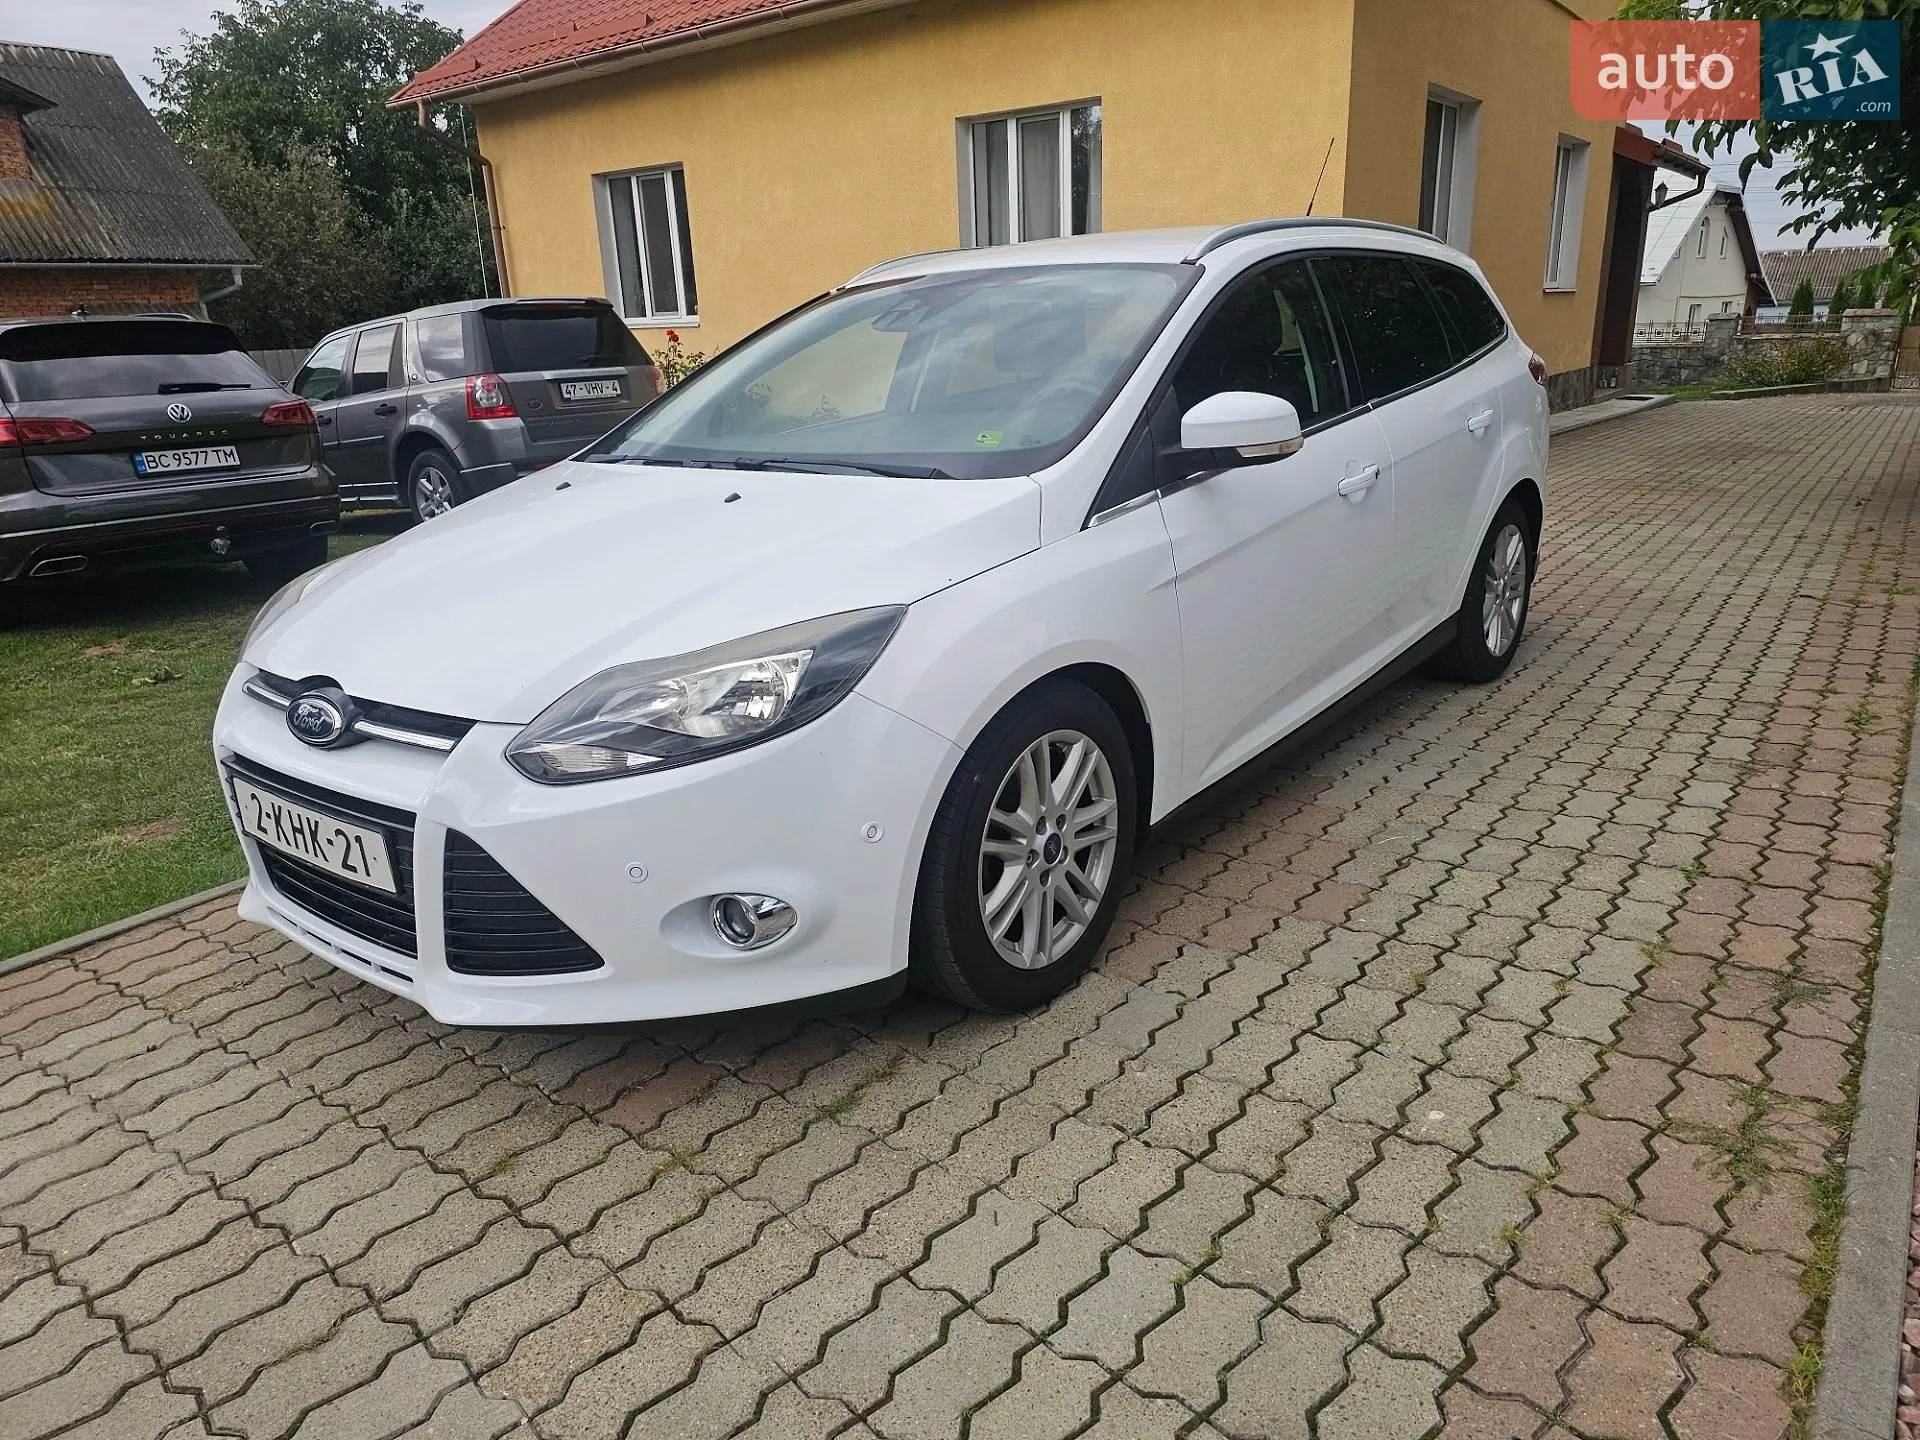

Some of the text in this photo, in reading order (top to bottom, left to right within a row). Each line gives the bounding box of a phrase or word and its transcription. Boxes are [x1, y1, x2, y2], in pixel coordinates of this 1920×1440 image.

[145, 454, 171, 469] BC
[172, 450, 208, 467] 9577
[211, 448, 236, 464] TM
[294, 703, 326, 732] Ford
[250, 792, 371, 878] 2-KHK-21
